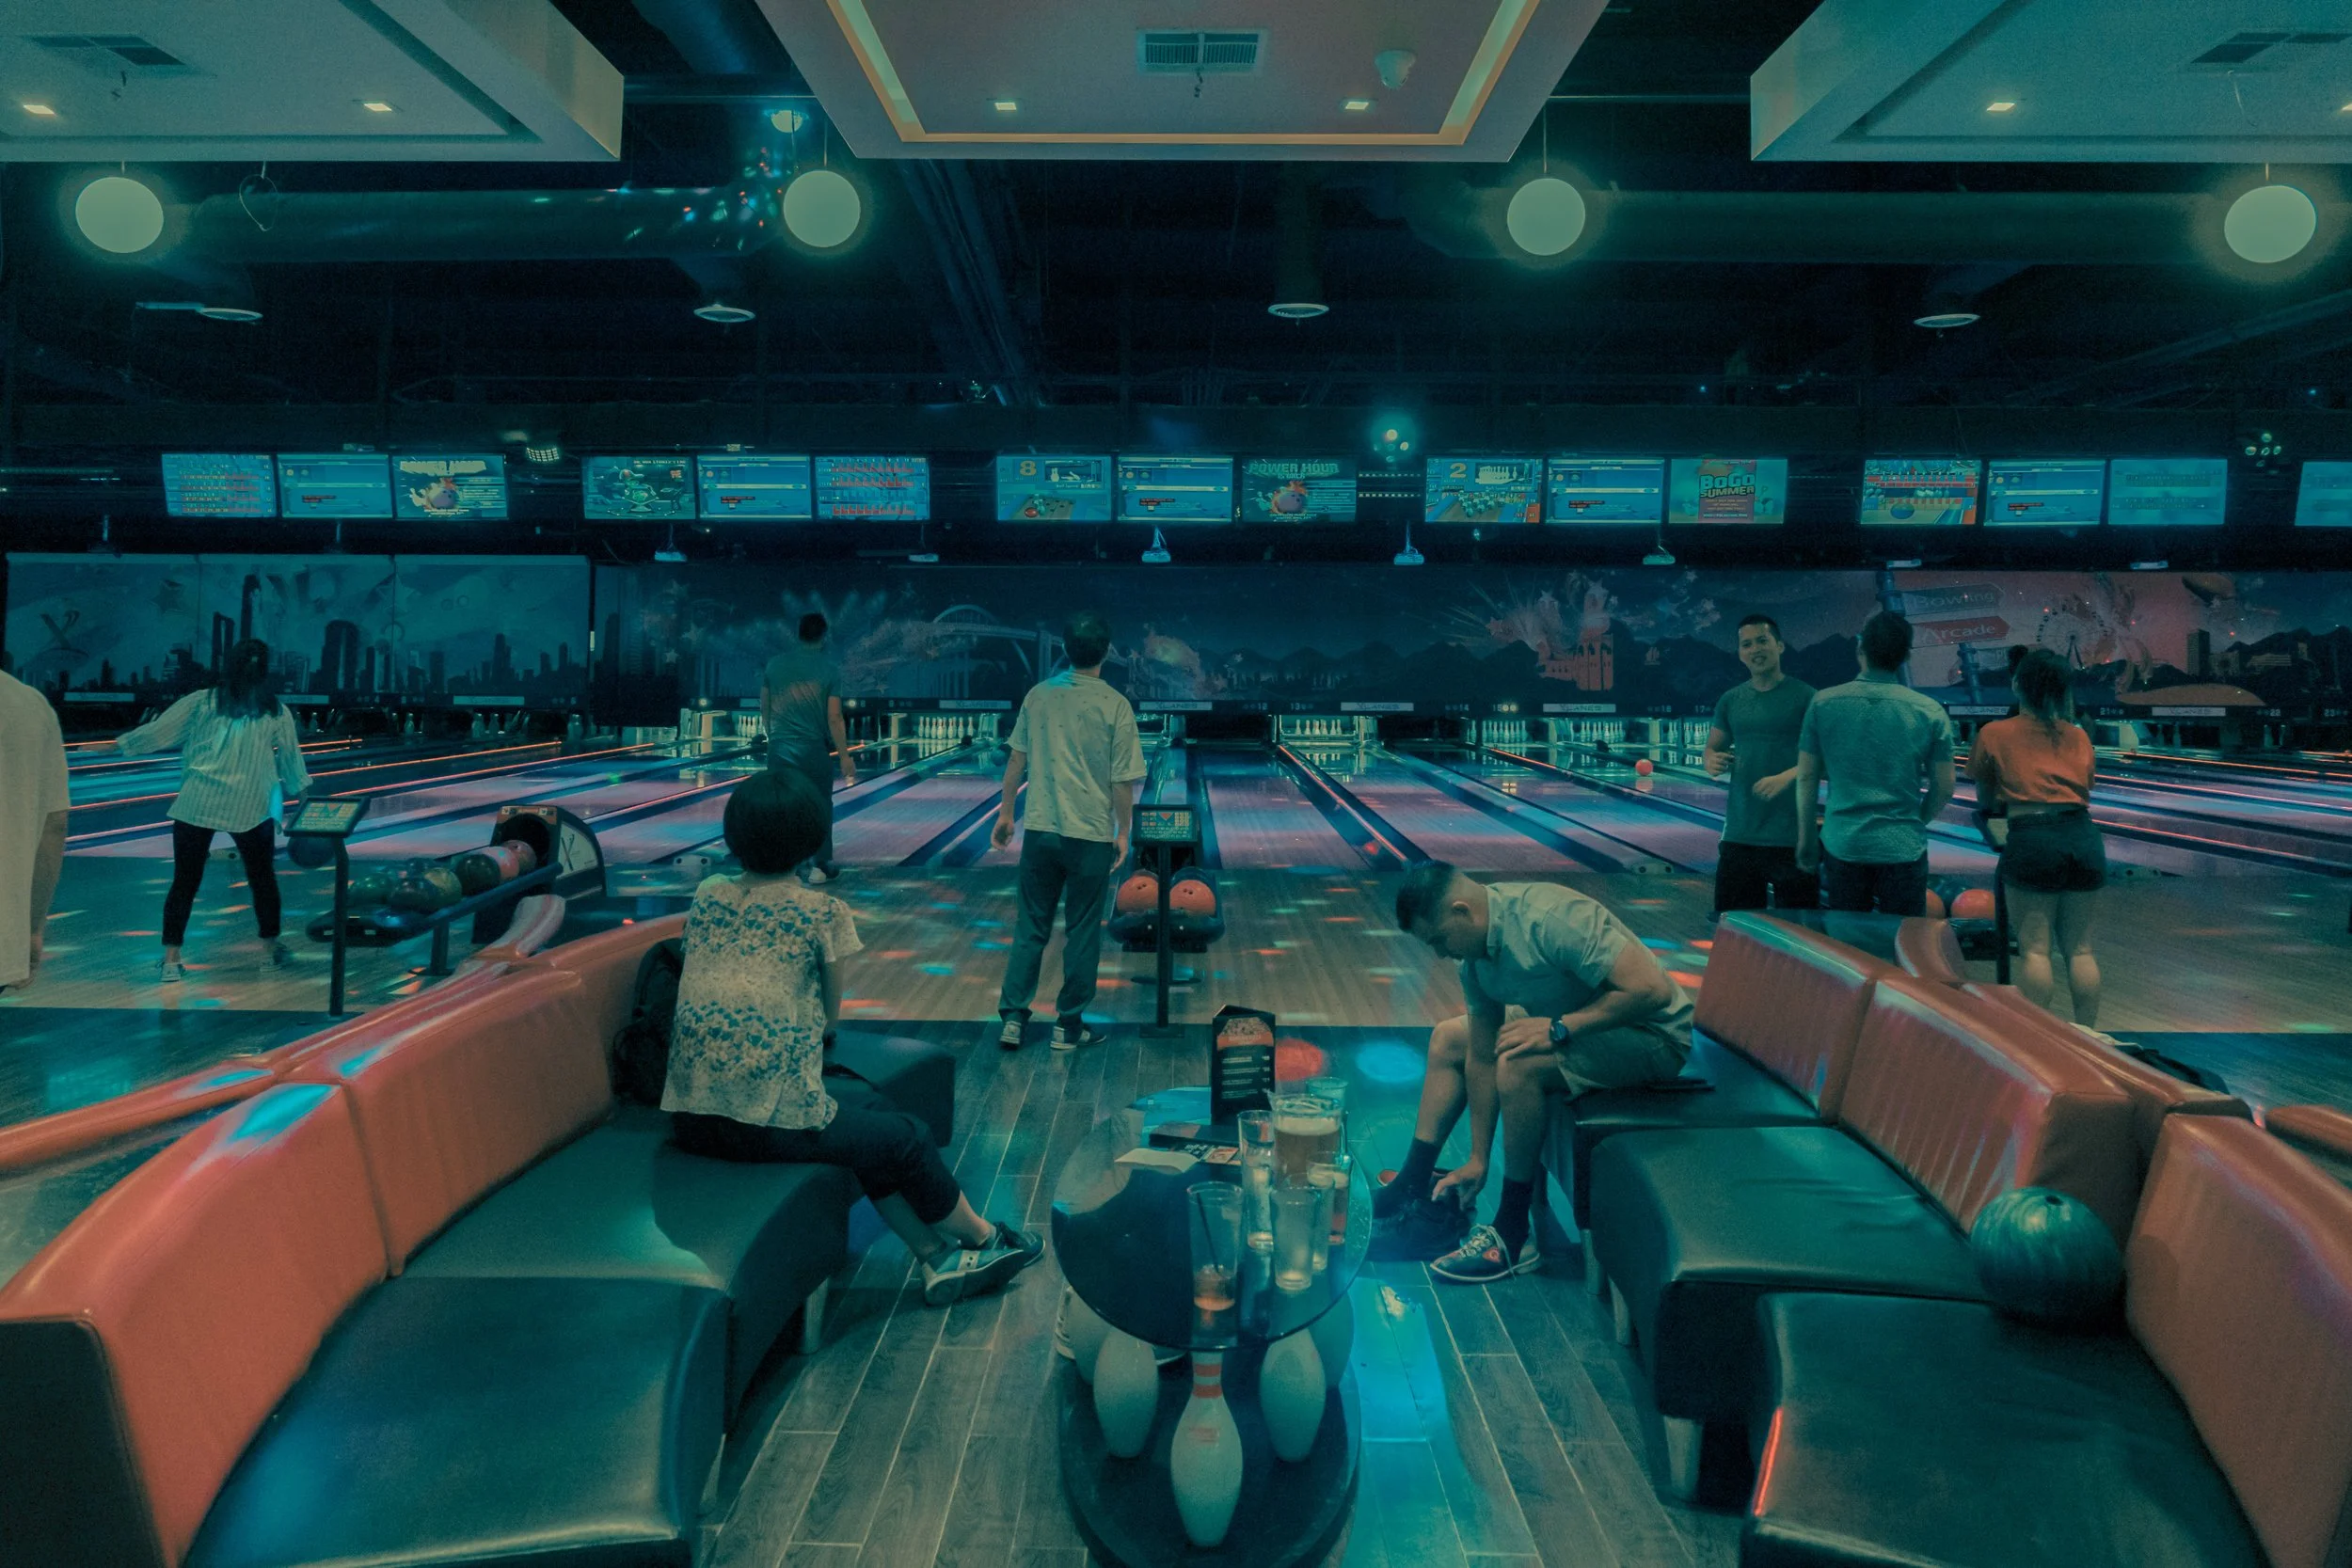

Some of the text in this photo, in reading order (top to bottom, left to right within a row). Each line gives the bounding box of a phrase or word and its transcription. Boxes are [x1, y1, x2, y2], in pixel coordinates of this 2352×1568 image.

[1019, 460, 1037, 476] 8
[1248, 463, 1340, 474] POWER HOUR
[1449, 462, 1467, 479] 2
[1700, 485, 1755, 499] SUMMER
[1914, 592, 1995, 608] Bowling
[1921, 625, 1996, 641] Arcade
